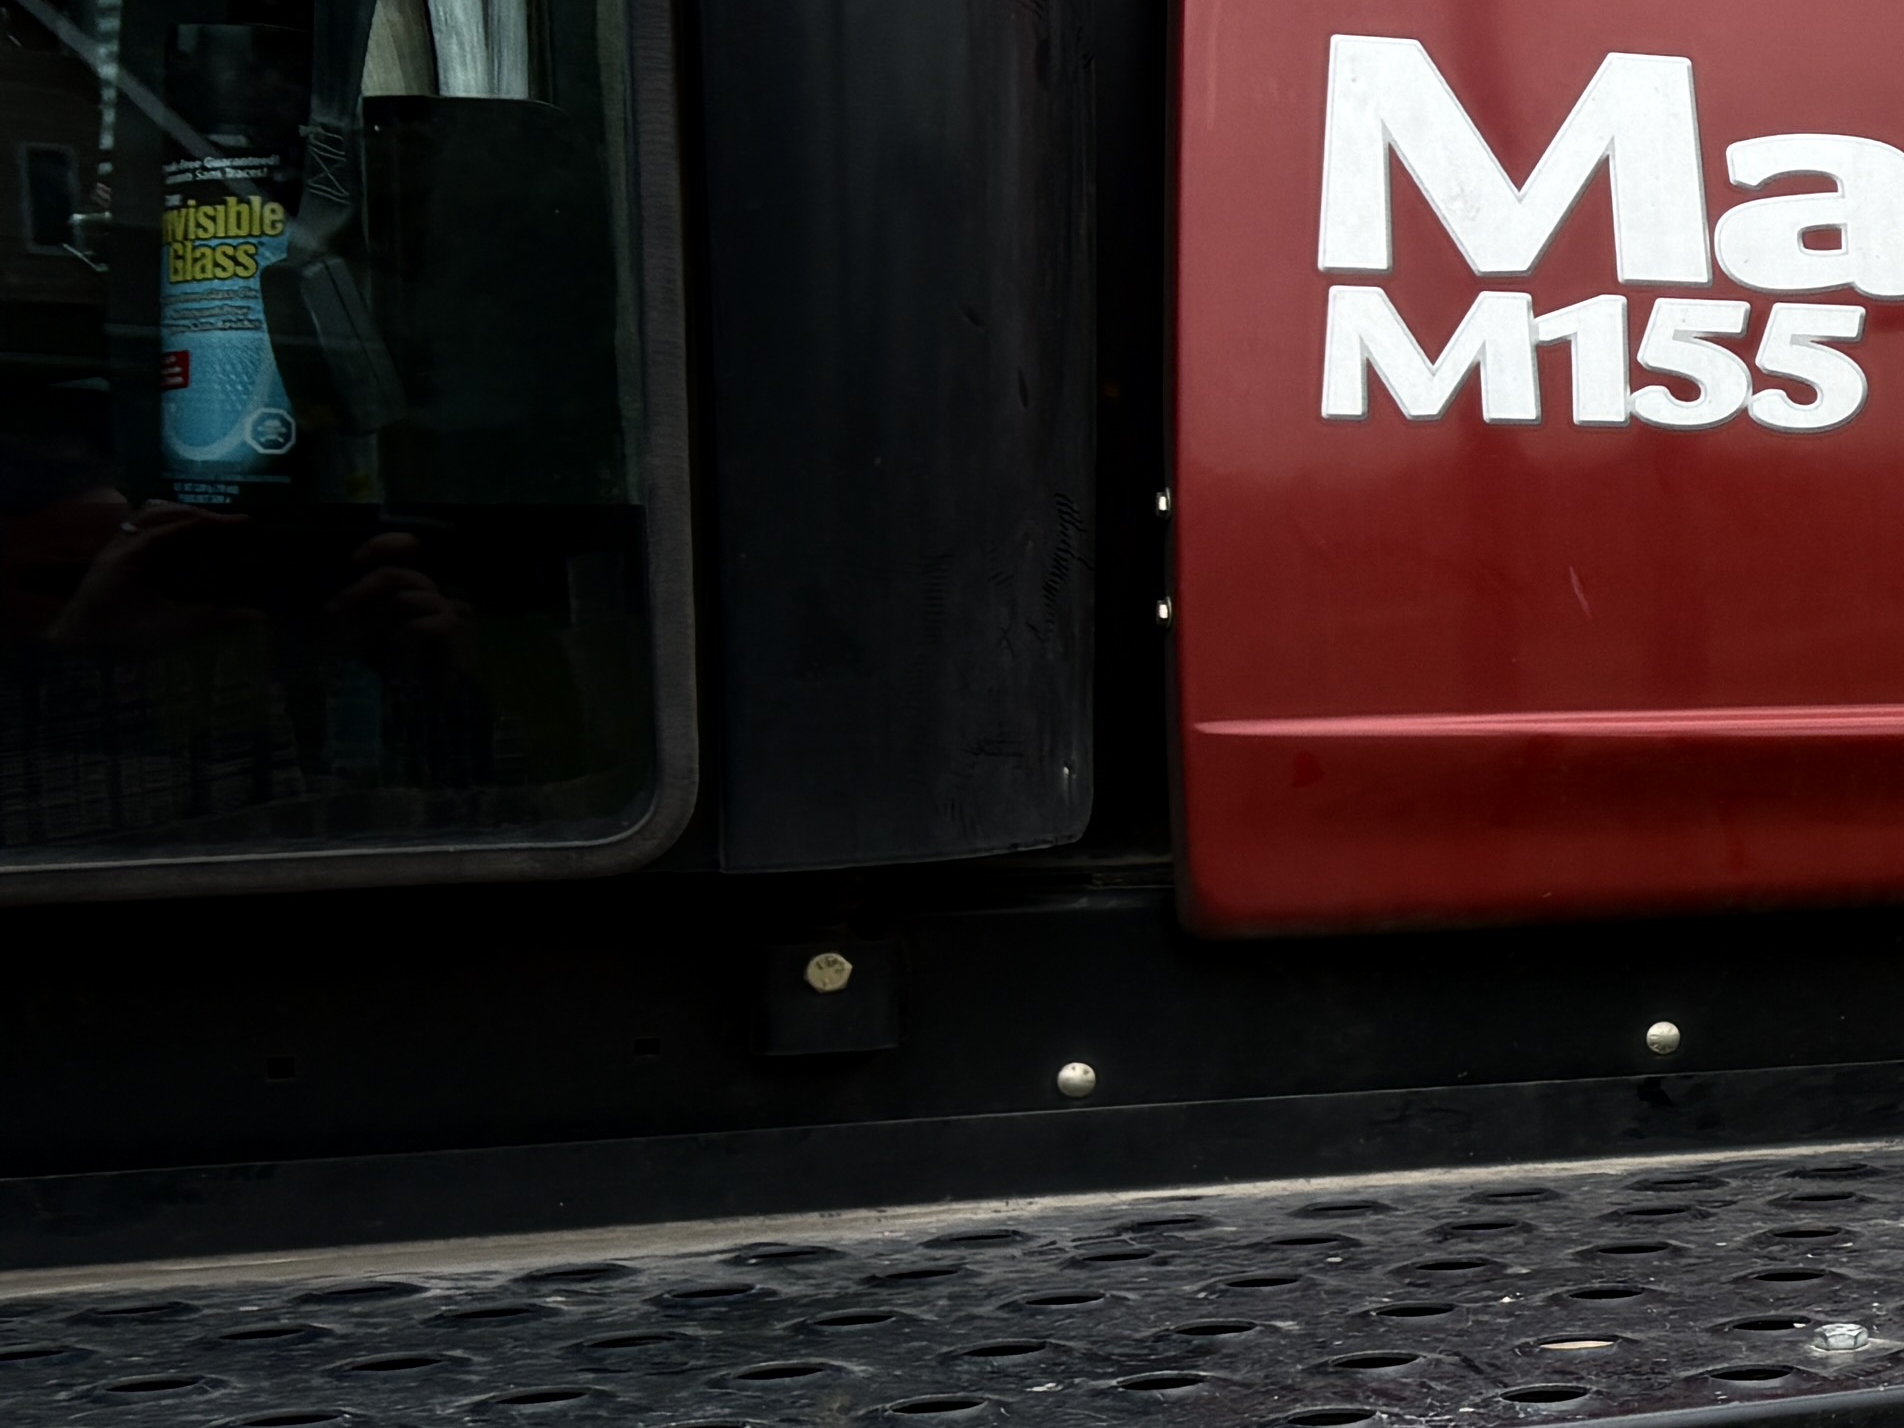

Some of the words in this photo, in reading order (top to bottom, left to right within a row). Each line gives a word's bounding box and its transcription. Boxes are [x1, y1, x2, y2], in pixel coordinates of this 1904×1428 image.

[163, 196, 285, 242] nvisible
[168, 241, 257, 283] Glass
[1321, 285, 1868, 434] M155
